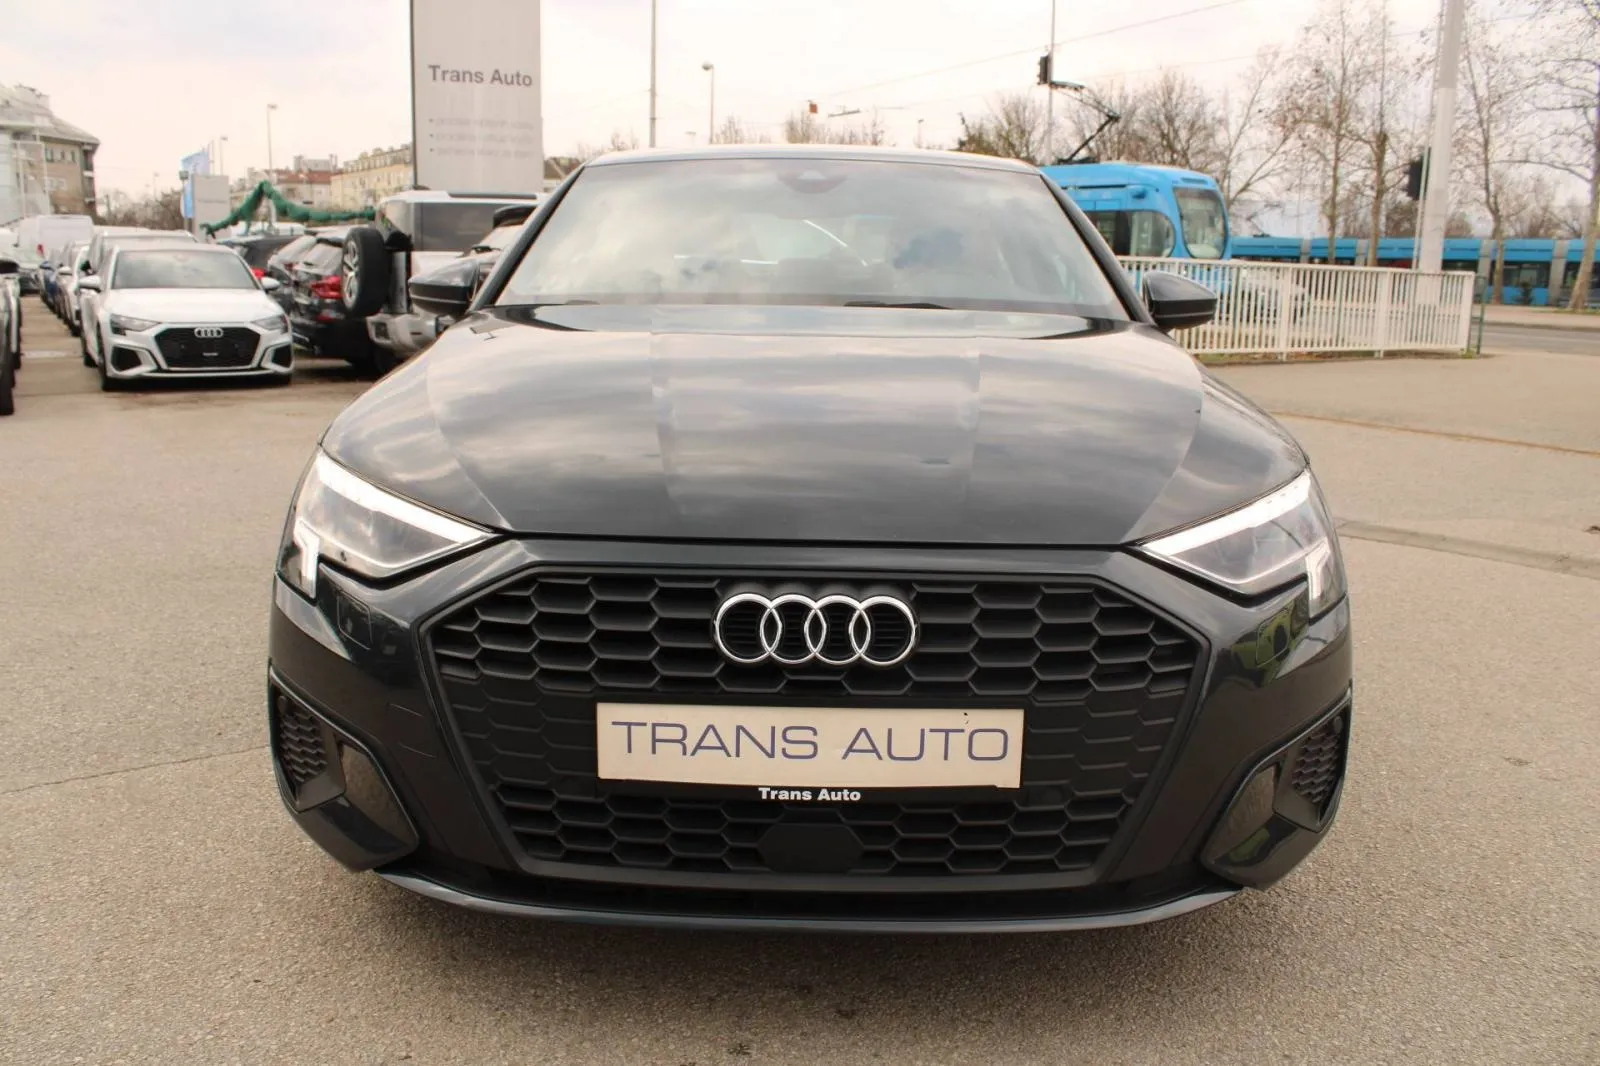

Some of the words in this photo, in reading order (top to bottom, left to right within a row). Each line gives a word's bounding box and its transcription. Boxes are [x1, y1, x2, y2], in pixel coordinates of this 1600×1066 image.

[428, 64, 484, 84] Trans
[490, 68, 533, 87] Auto
[611, 721, 819, 760] TRANS
[841, 727, 1009, 762] AUTO
[758, 787, 812, 800] Trans
[817, 788, 861, 801] Auto
